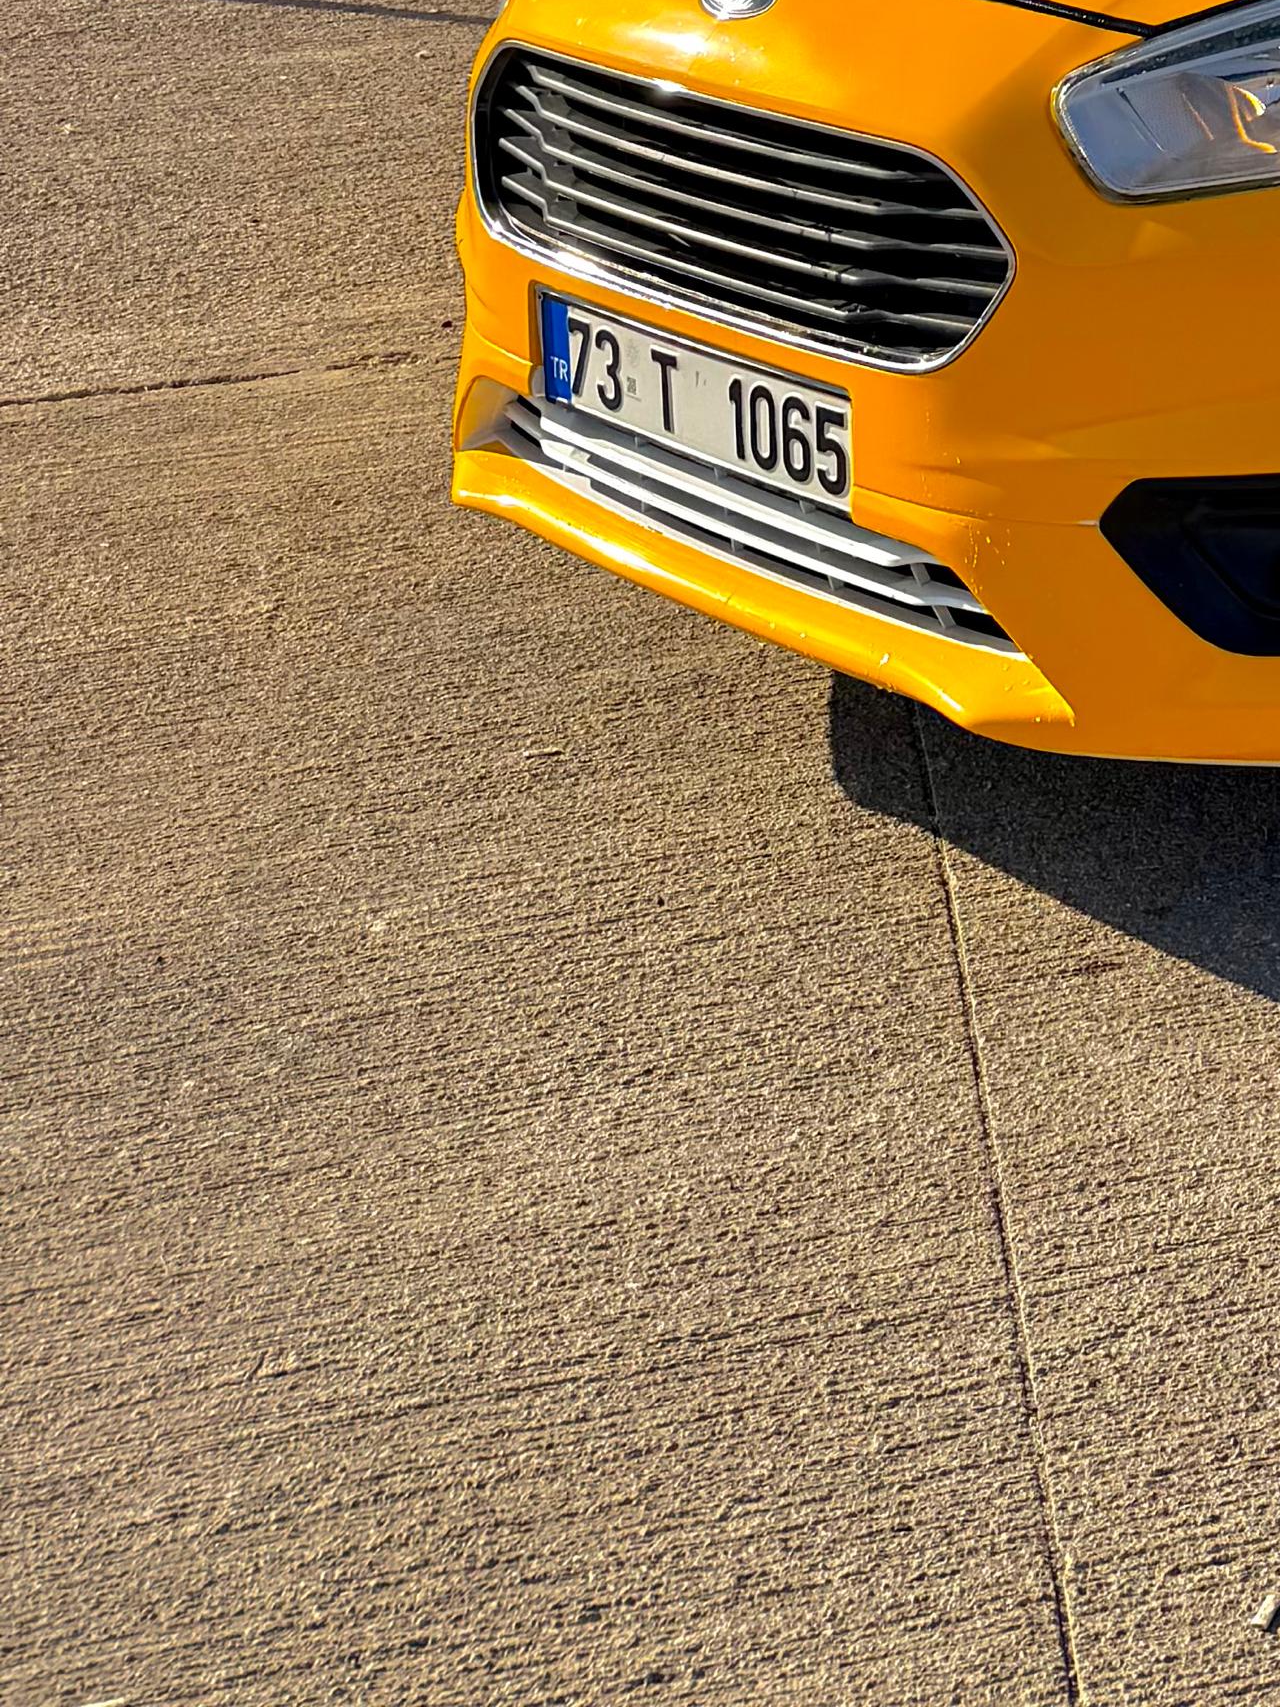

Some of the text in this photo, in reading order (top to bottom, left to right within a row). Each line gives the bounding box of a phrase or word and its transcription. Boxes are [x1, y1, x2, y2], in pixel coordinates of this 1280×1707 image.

[550, 316, 851, 497] TR 73 T 1065
